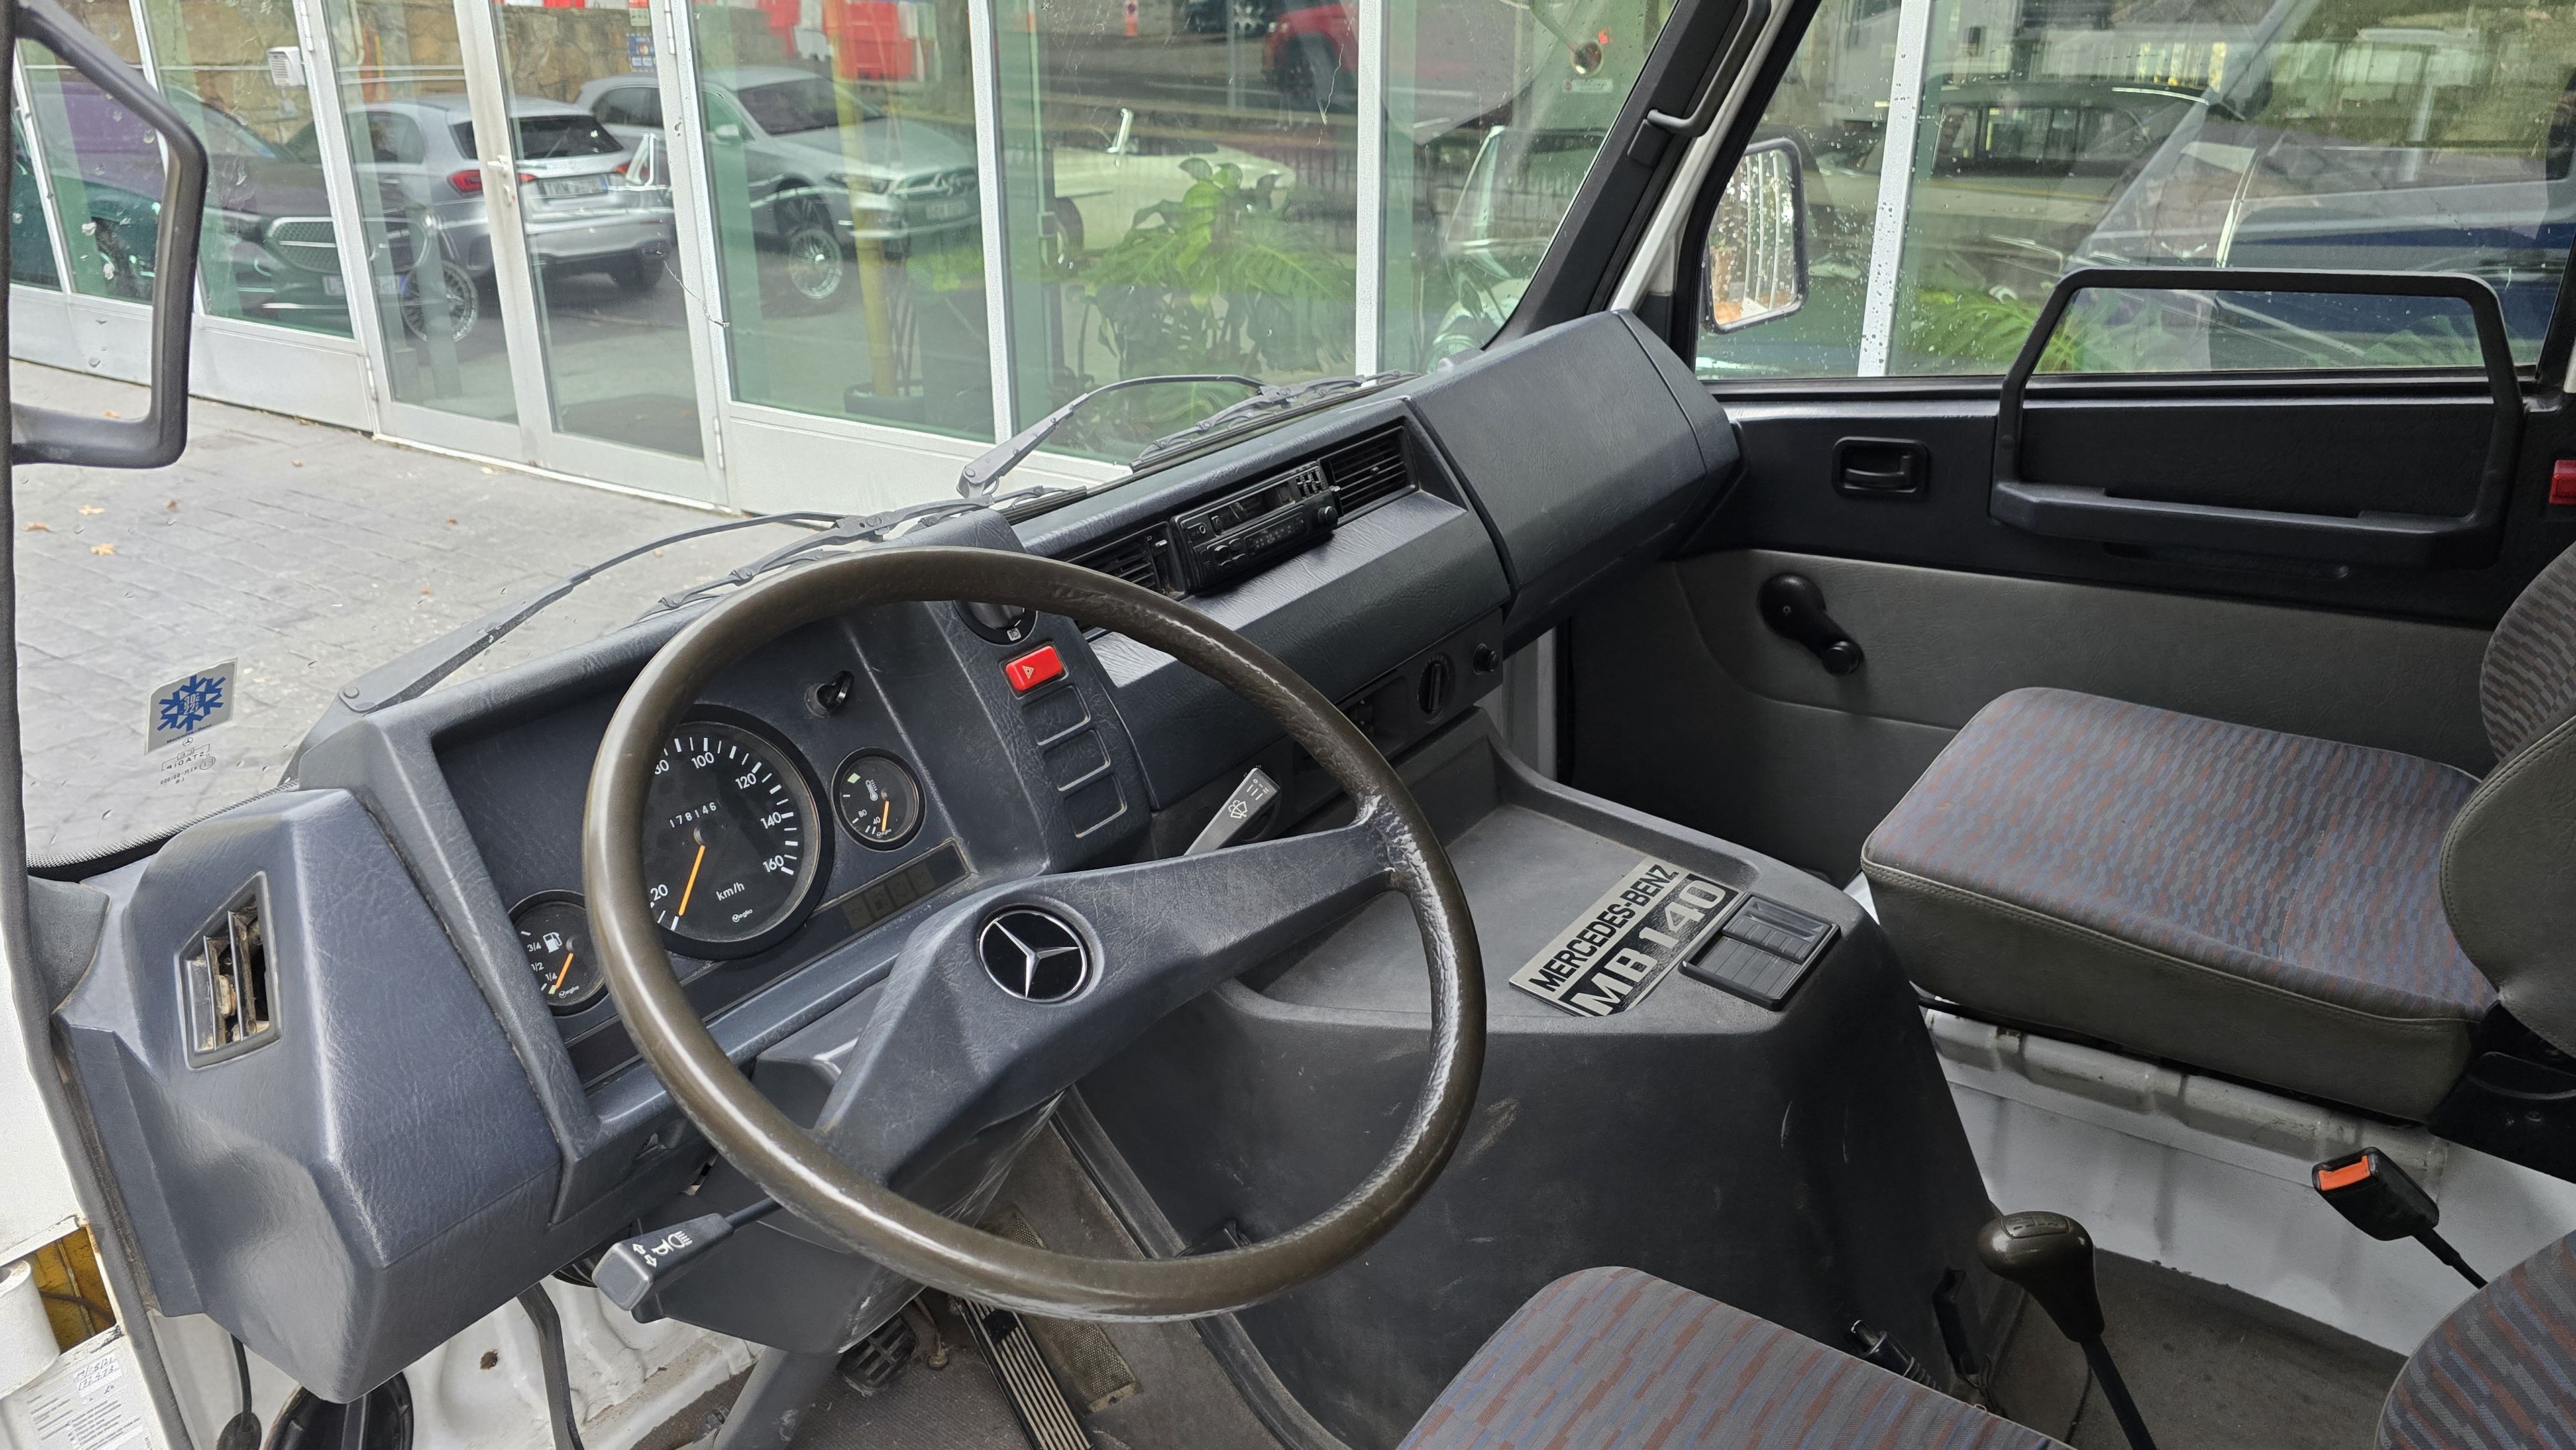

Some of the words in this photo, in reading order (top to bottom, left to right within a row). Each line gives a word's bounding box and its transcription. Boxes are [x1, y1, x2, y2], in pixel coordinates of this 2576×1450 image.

[691, 751, 714, 769] 100
[735, 773, 757, 789] 120
[669, 801, 717, 828] 178146
[760, 812, 782, 830] 140
[858, 809, 867, 818] 80
[873, 816, 881, 824] 40
[763, 854, 784, 873] 160
[650, 884, 669, 901] 20
[716, 882, 745, 901] km/h
[1528, 864, 1679, 993] MERCEDES-BENZ
[527, 942, 541, 952] 3/4
[1570, 947, 1658, 1017] MB
[1639, 879, 1726, 949] 140
[531, 962, 544, 972] 1/2
[545, 972, 557, 982] 1/4
